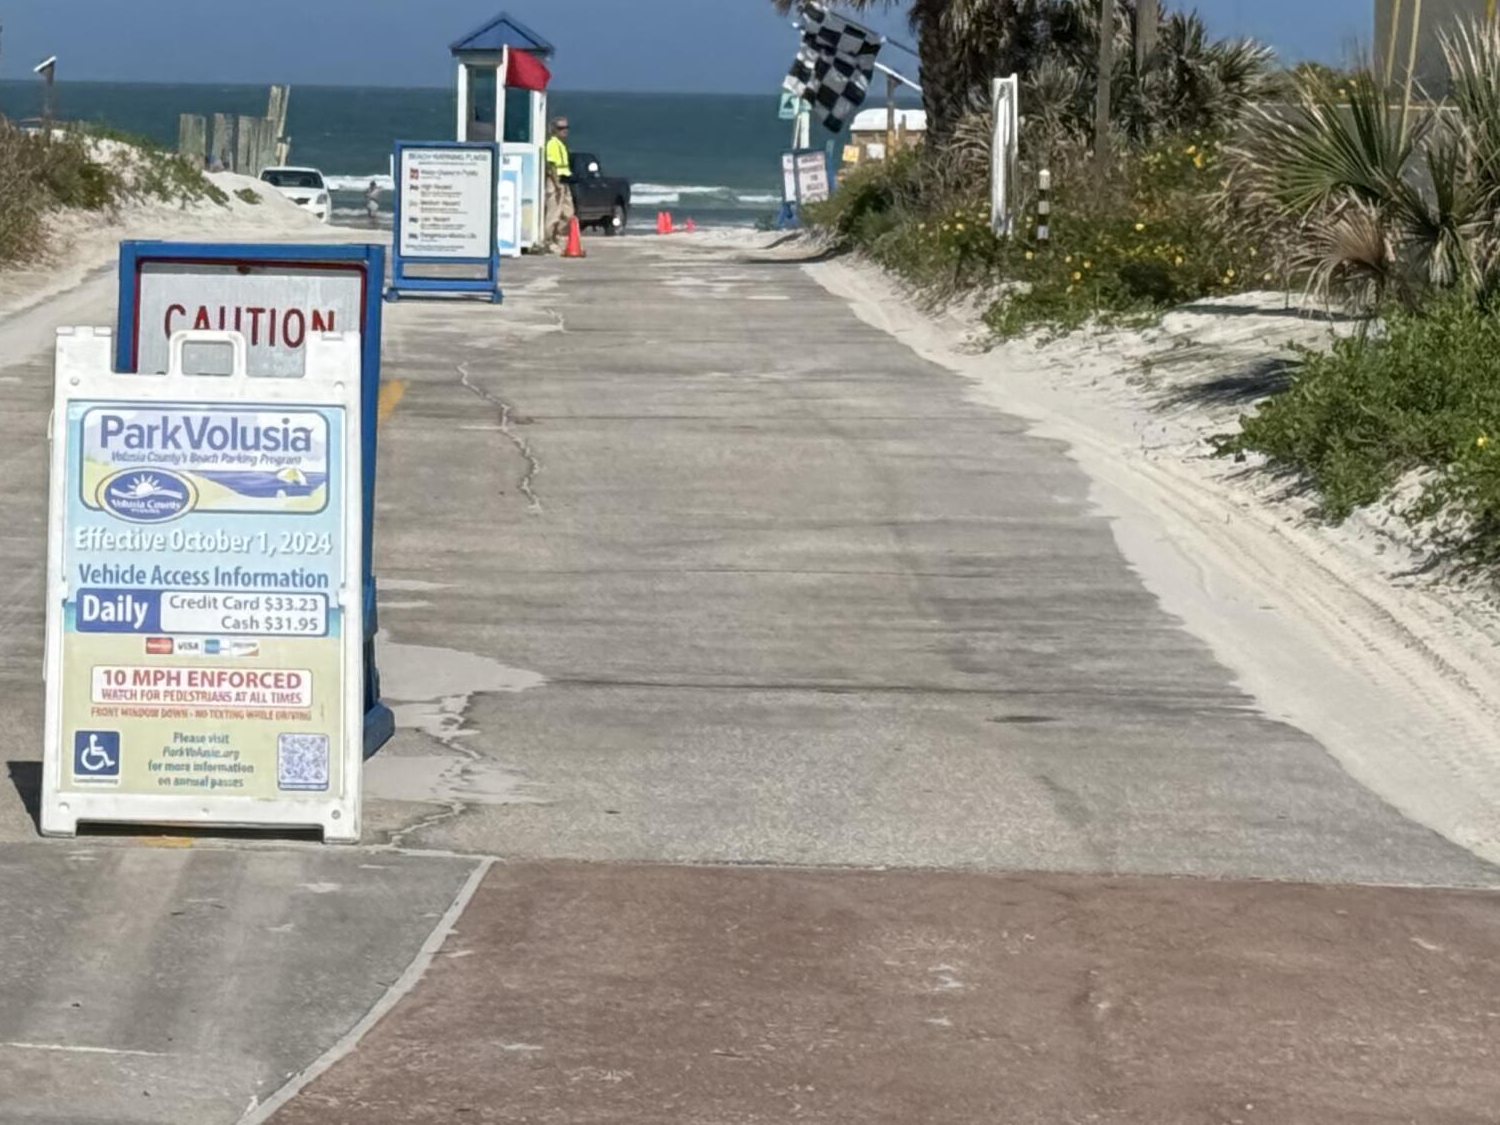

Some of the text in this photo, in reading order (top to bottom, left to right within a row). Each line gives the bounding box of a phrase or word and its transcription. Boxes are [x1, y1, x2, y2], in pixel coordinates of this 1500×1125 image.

[164, 304, 335, 348] CAUTION
[100, 414, 313, 452] ParkVolusia
[111, 451, 302, 467] Volusia County's Beach Parking Program
[75, 526, 332, 557] Effective October 1, 2024
[78, 563, 329, 588] Vehicle Access Information
[82, 593, 149, 629] Daily
[169, 595, 319, 613] Credit Card $33.23
[220, 615, 319, 632] Cash $31.95
[177, 641, 200, 651] VISA
[102, 669, 302, 689] 10 MPH ENFORCED
[101, 688, 302, 704] WATCH FOR PEDESTRIANS AT ALL TIMES
[91, 707, 119, 718] FRONT
[120, 707, 159, 719] WINDOW
[161, 708, 188, 719] DOWN
[195, 709, 209, 719] NO
[210, 710, 245, 720] TEXTING
[173, 732, 230, 744] Please visit
[148, 761, 254, 773] for more information
[158, 776, 244, 790] on annual passes
